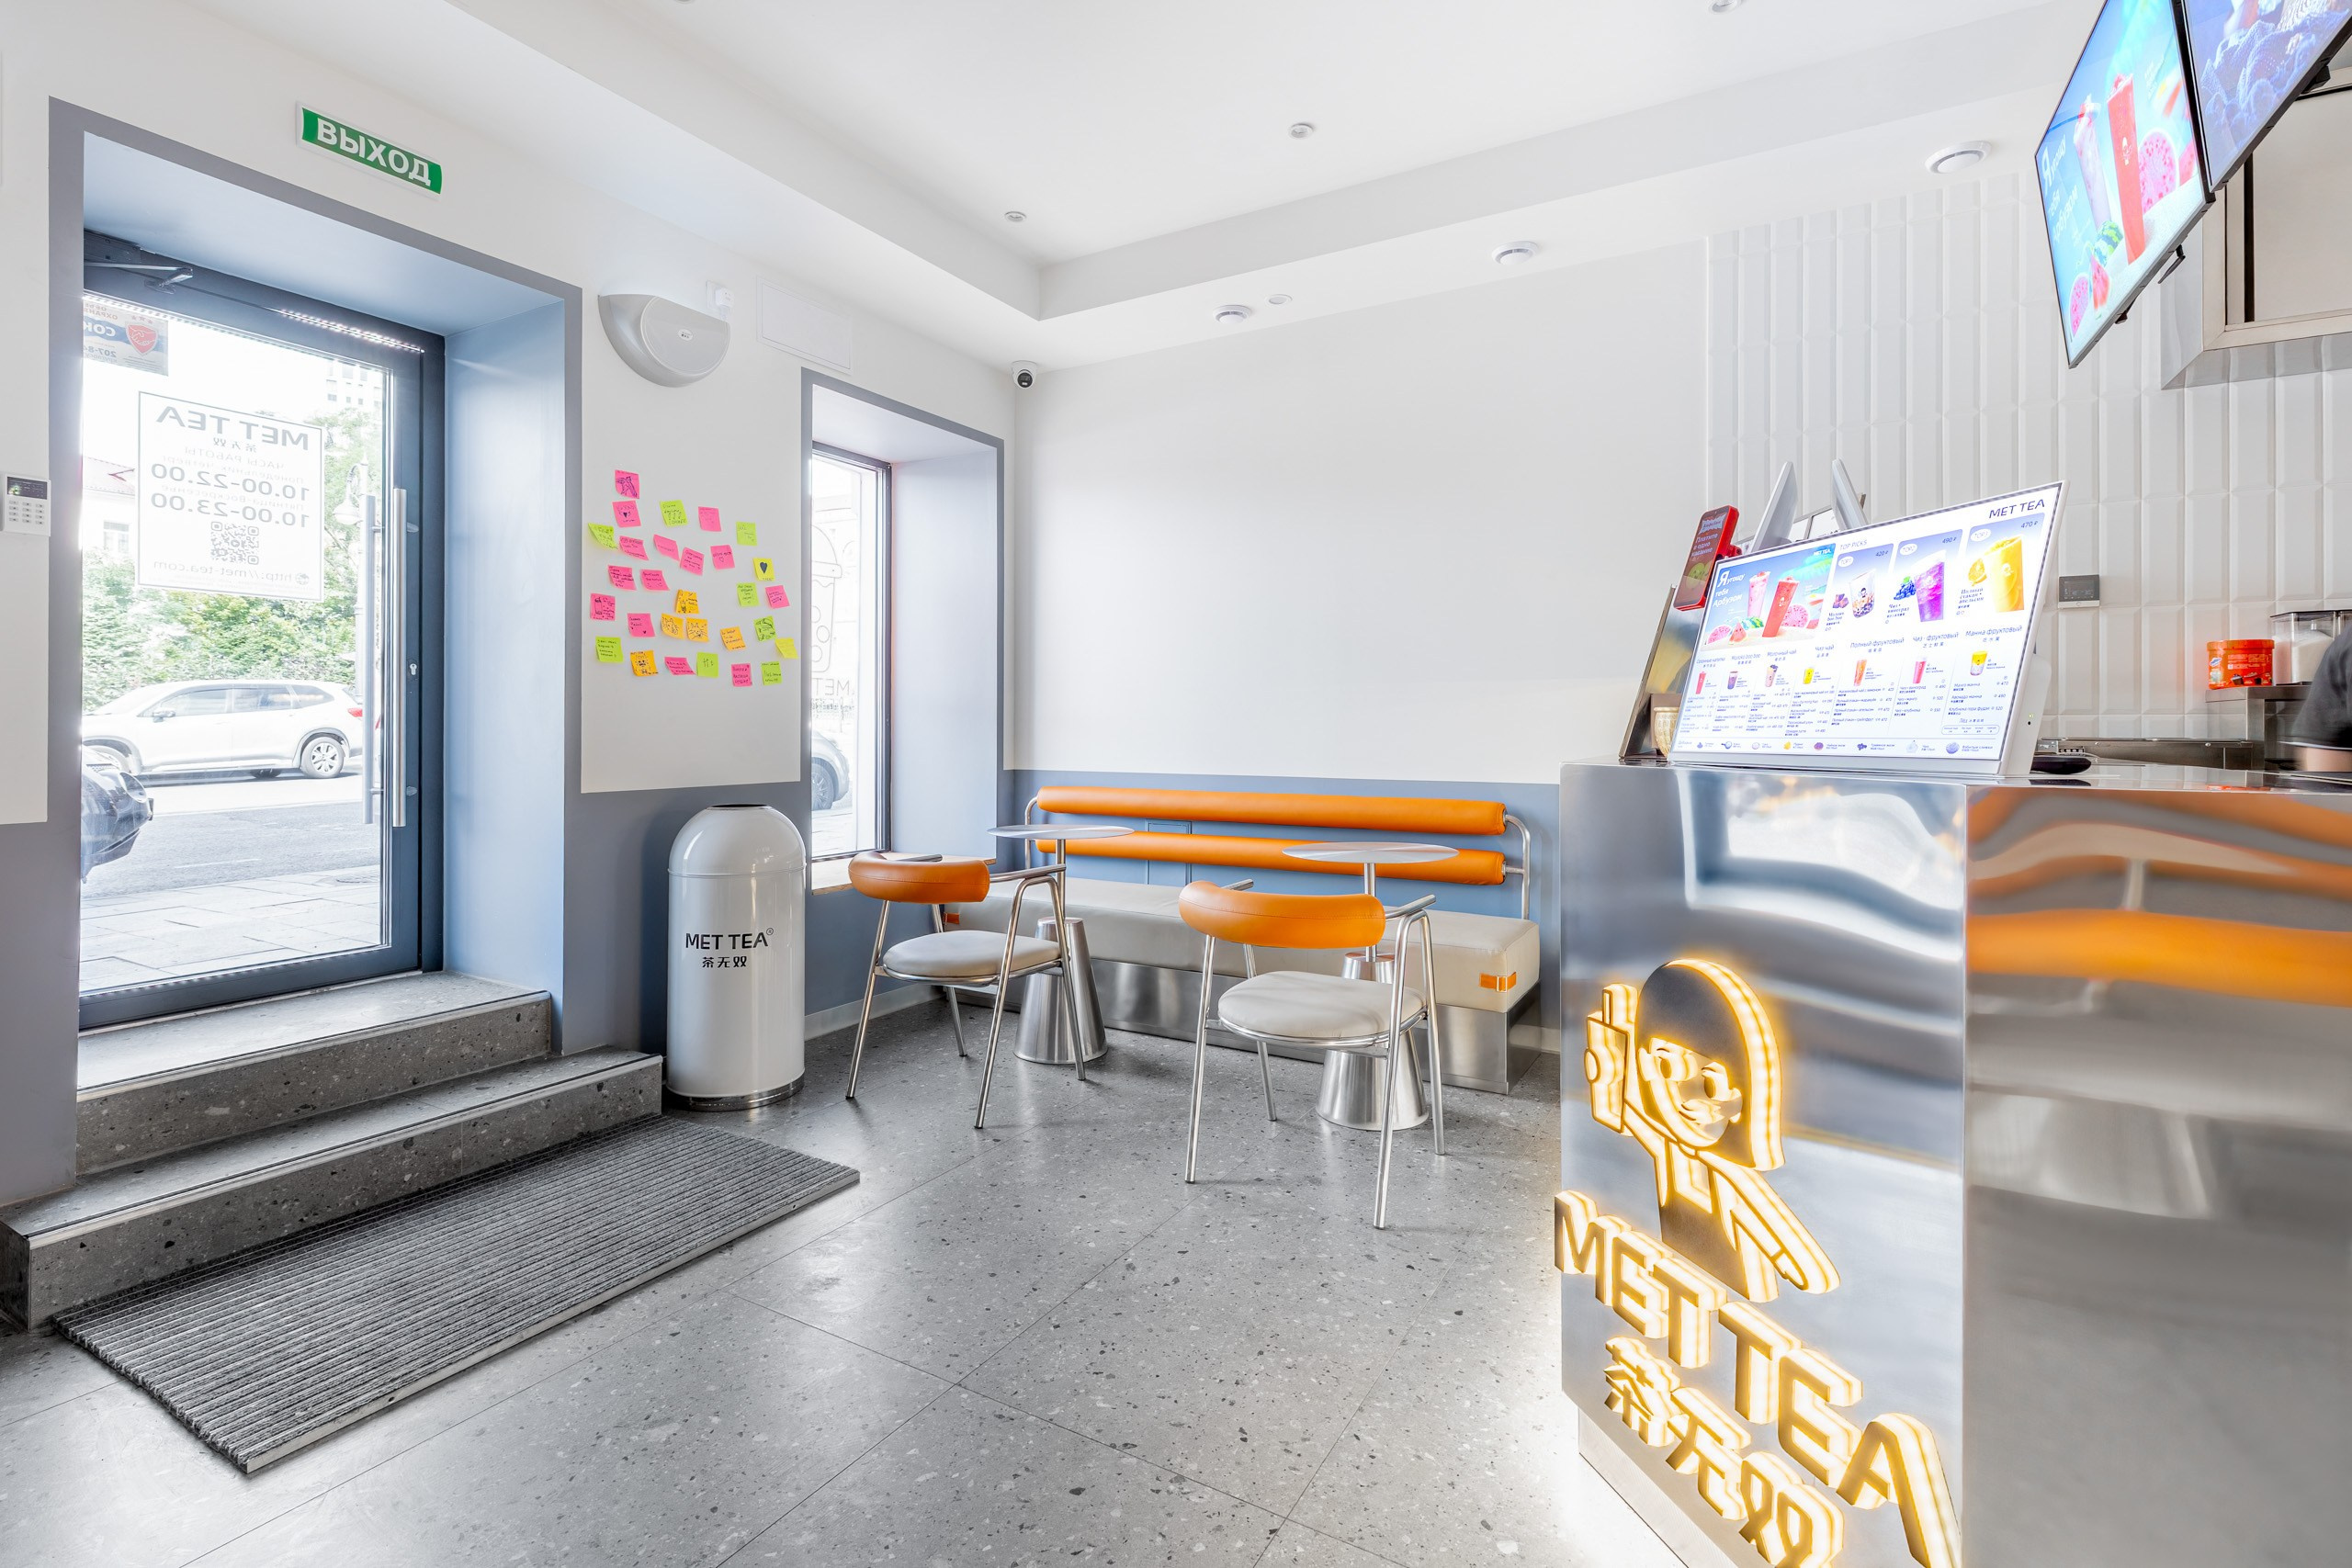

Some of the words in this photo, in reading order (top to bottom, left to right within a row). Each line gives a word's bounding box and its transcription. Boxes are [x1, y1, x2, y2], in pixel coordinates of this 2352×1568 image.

[317, 118, 431, 186] ВЫХОД
[1989, 504, 2017, 519] MET
[2019, 499, 2045, 513] TEA
[1717, 570, 1730, 587] Я
[1849, 640, 1872, 649] Полный
[685, 932, 724, 950] MET
[728, 931, 769, 950] TEA
[702, 955, 748, 968] 茶无双
[1555, 1190, 1727, 1369] MET
[1718, 1301, 1962, 1568] TEA
[1604, 1336, 1845, 1568] 茶无双
